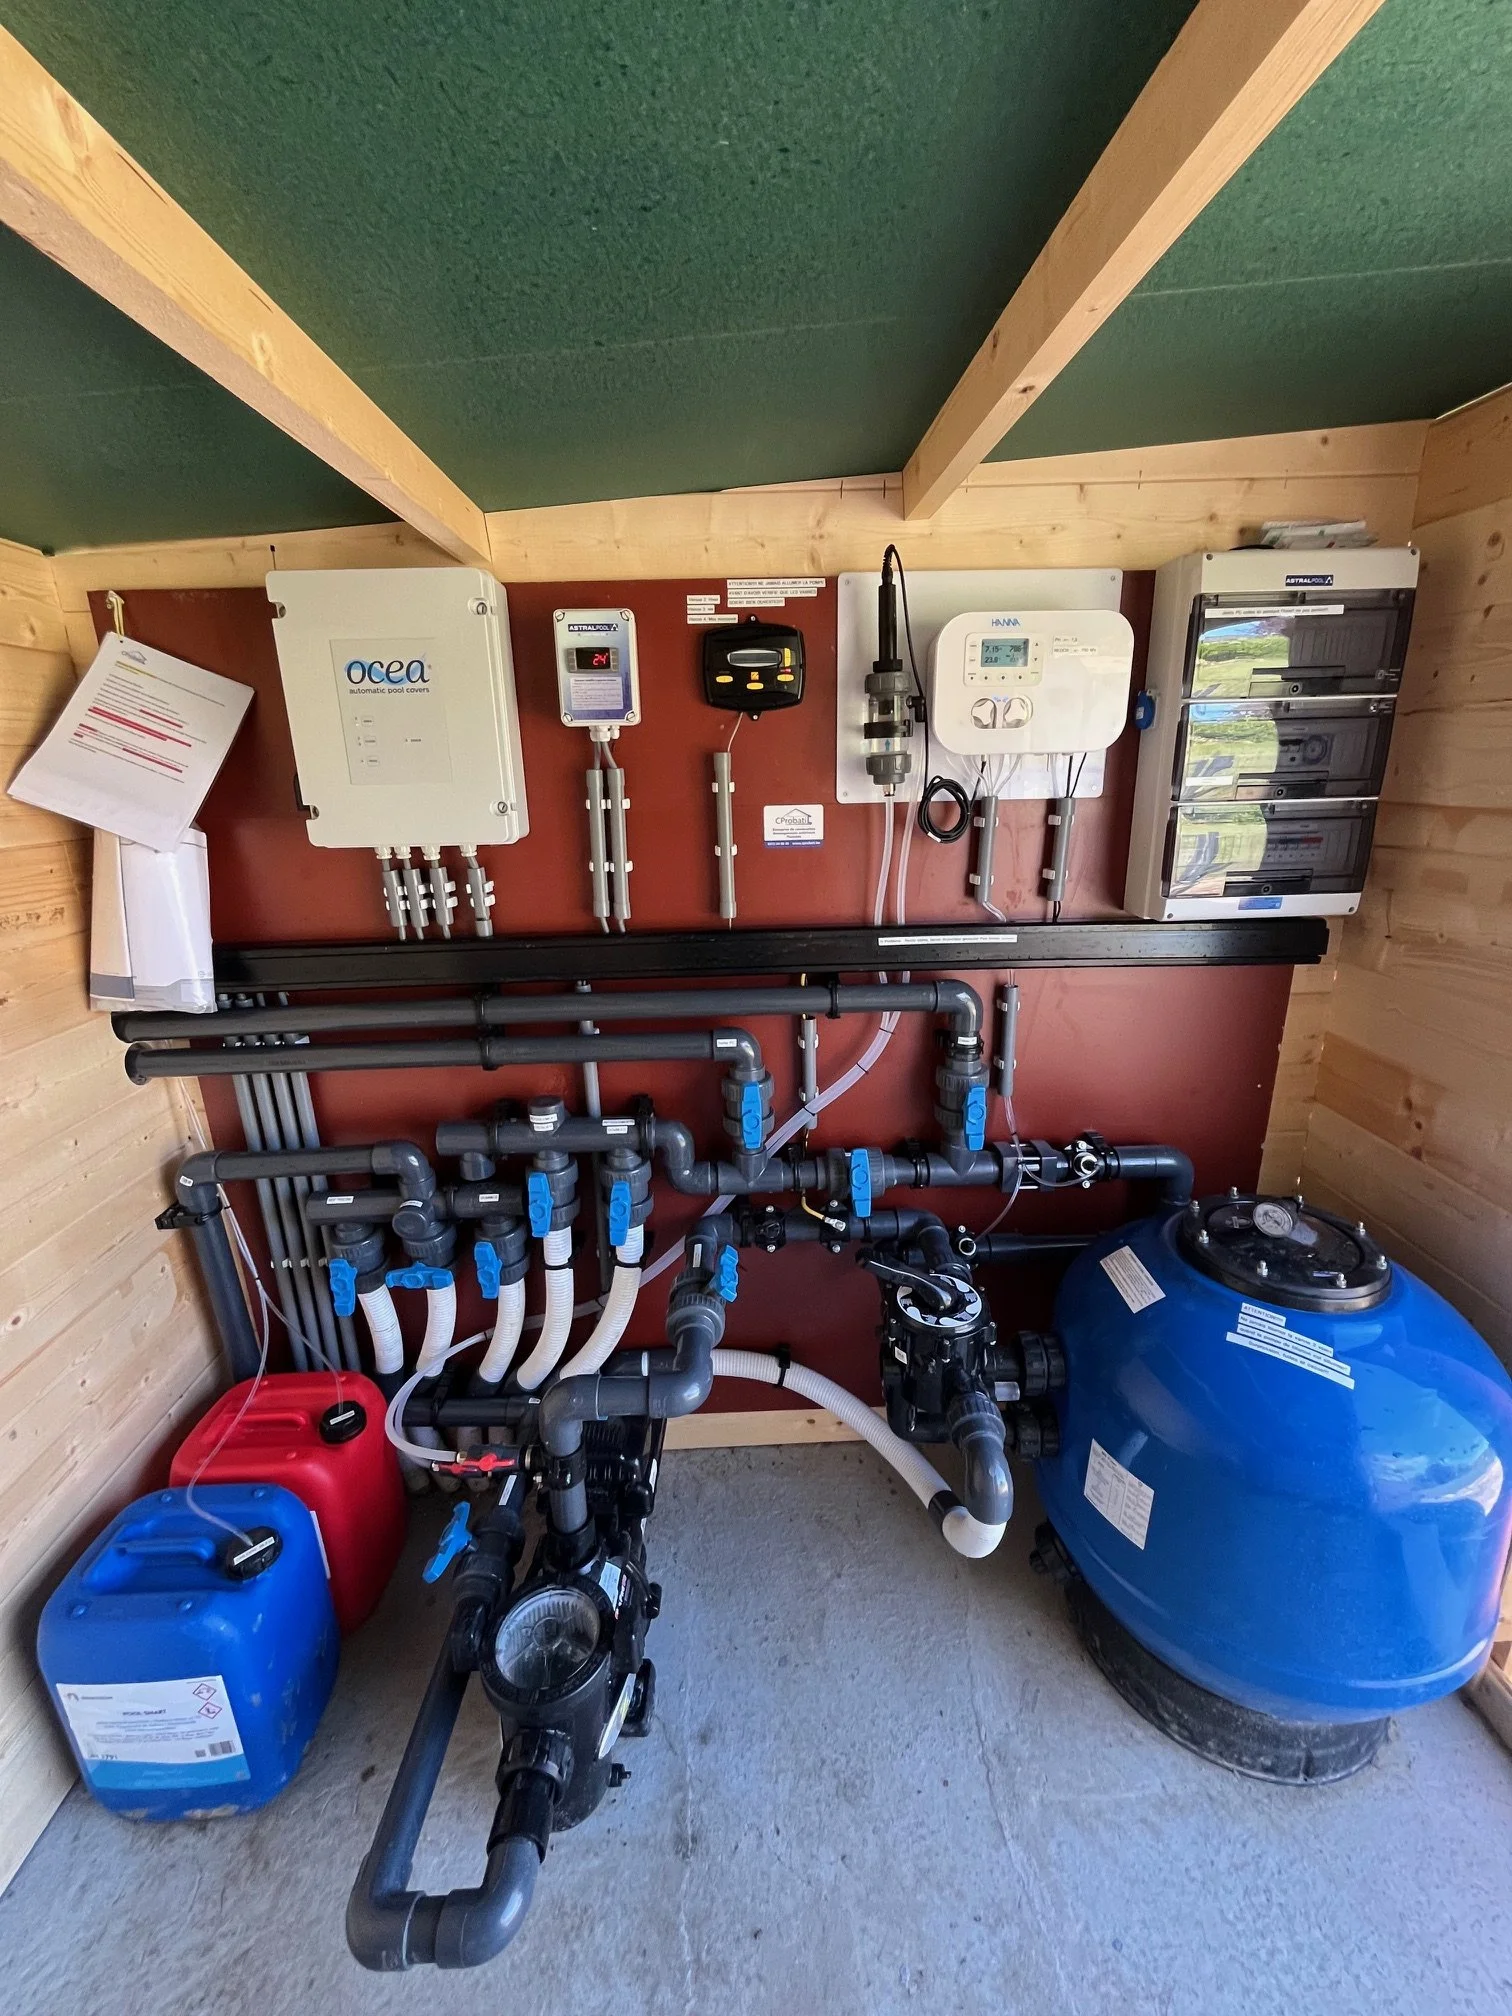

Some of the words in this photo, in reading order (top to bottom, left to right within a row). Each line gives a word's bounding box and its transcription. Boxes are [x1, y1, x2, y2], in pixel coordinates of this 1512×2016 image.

[992, 618, 1021, 627] HANNA
[347, 660, 430, 684] ocea
[349, 687, 386, 695] automatic
